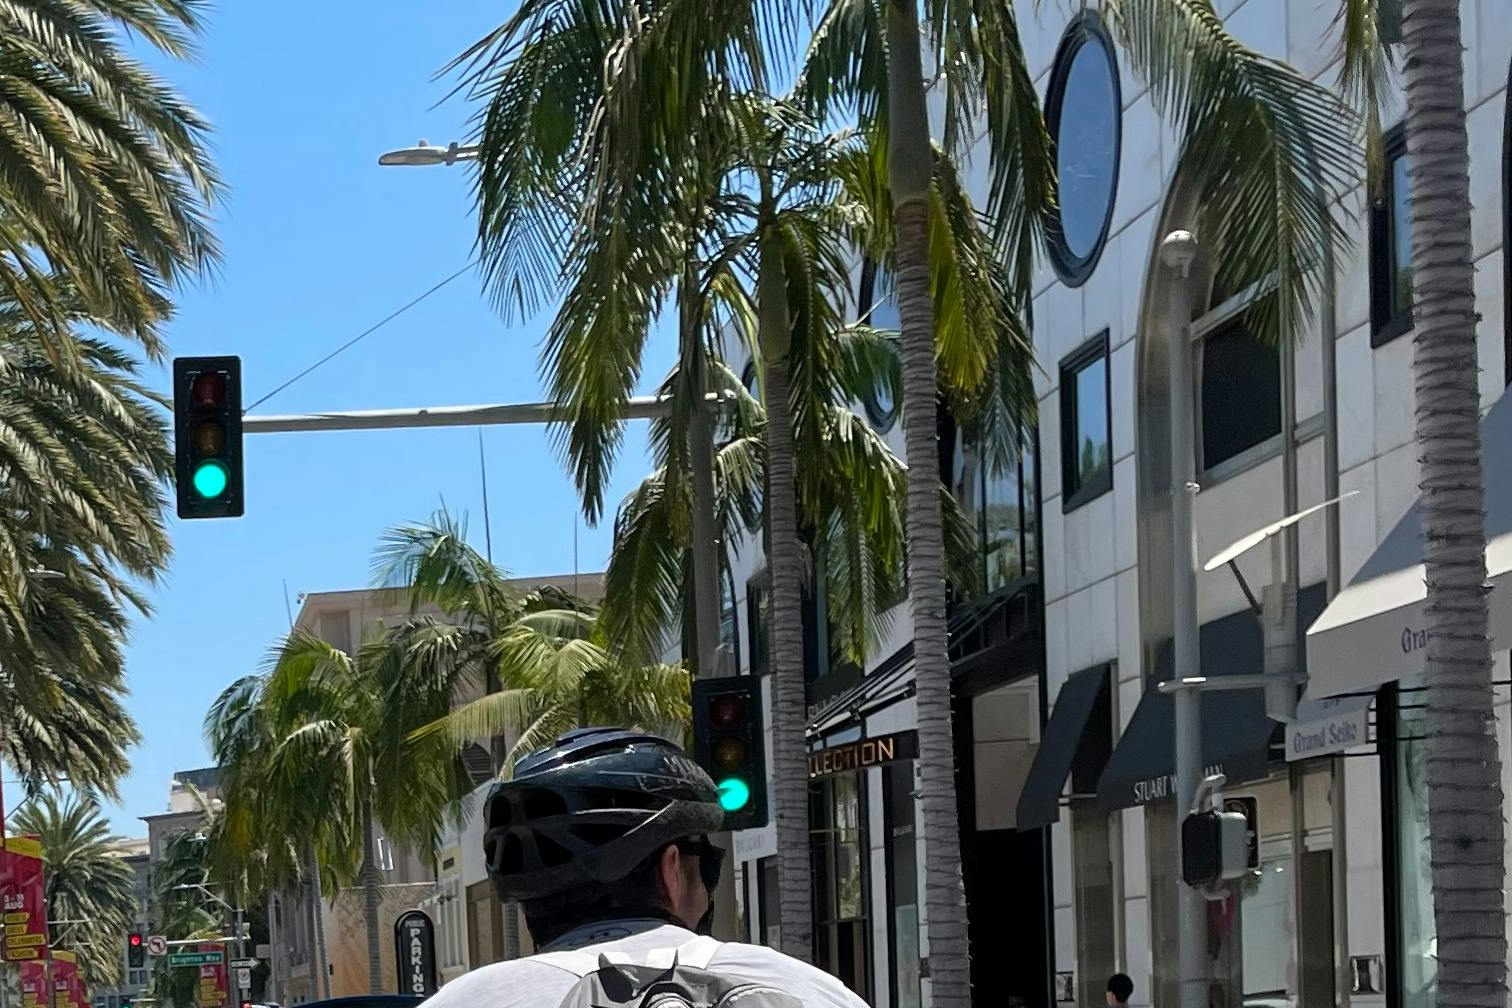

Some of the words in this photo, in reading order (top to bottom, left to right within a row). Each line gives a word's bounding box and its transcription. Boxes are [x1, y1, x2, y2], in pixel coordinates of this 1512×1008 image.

[1401, 627, 1429, 653] Gra
[1293, 728, 1325, 753] Grand
[809, 738, 894, 777] LLECTION
[1134, 775, 1168, 803] STUART
[409, 928, 425, 993] PARKING
